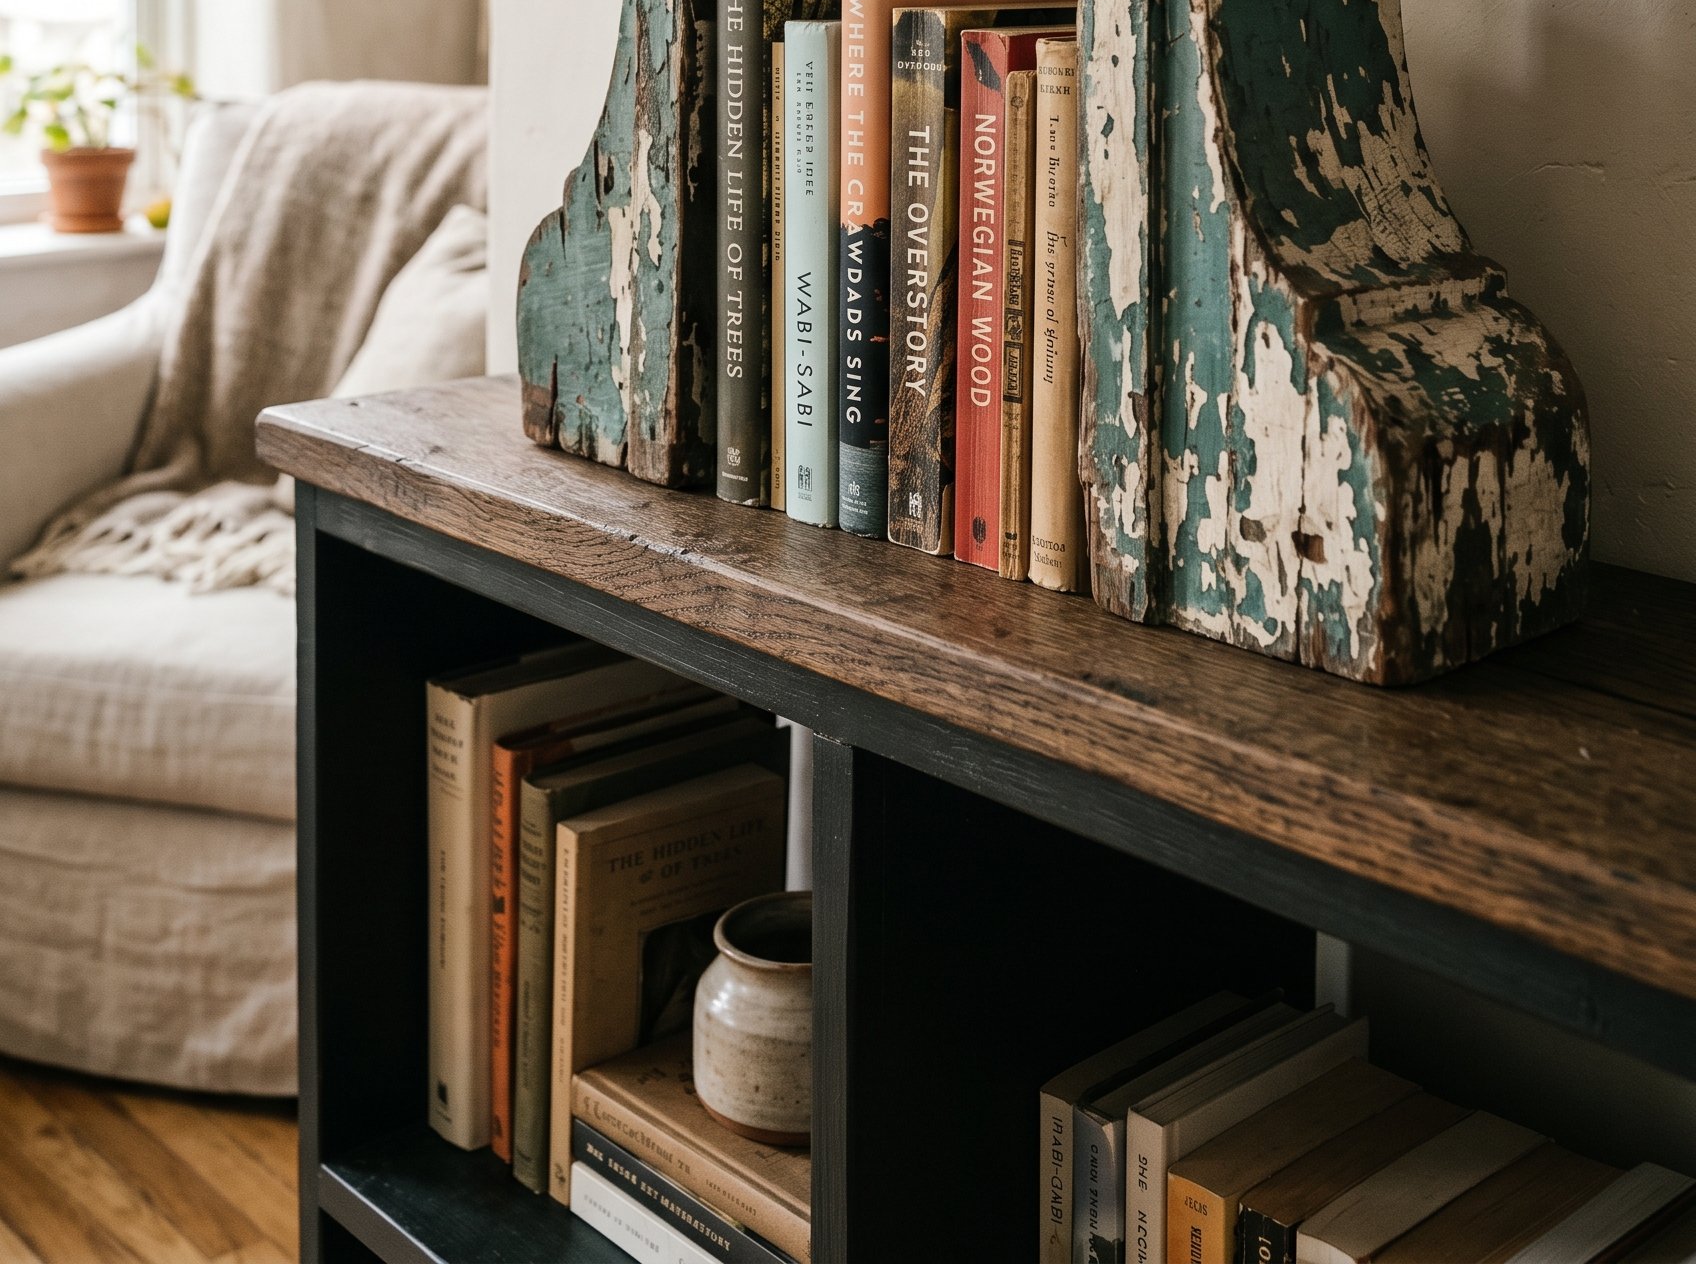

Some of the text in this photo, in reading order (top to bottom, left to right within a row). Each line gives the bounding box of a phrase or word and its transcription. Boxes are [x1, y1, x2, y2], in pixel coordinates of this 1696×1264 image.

[727, 44, 743, 160] HIDDEN
[847, 110, 865, 167] THE
[727, 169, 743, 231] LIFE
[727, 243, 742, 281] OF
[846, 179, 864, 342] CRAWDADS
[905, 125, 930, 397] THE OVERSTORY
[970, 114, 997, 407] NORWEGIAN WOOD
[726, 290, 743, 379] TREES
[796, 271, 813, 427] WABI-SABI
[846, 355, 862, 424] SING
[608, 850, 645, 873] THE
[653, 831, 722, 861] HIDDEN
[660, 860, 684, 878] OF
